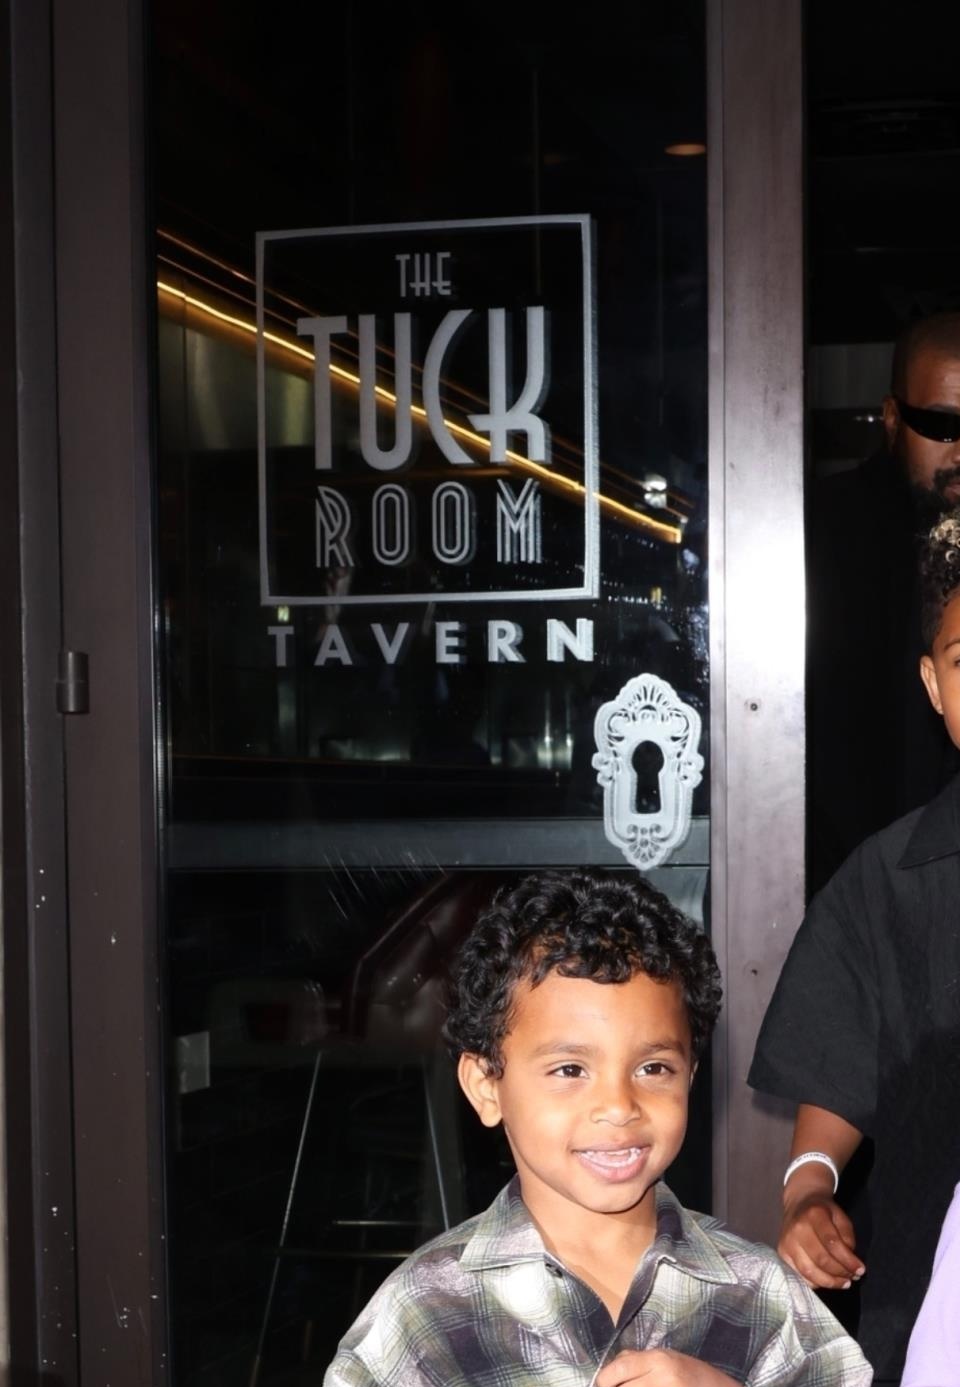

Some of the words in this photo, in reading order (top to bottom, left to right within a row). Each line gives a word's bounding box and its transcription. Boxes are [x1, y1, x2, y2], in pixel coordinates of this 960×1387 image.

[396, 251, 451, 297] THE
[297, 305, 552, 471] TUCK
[316, 478, 543, 567] ROOM
[267, 617, 594, 667] TAVERN
